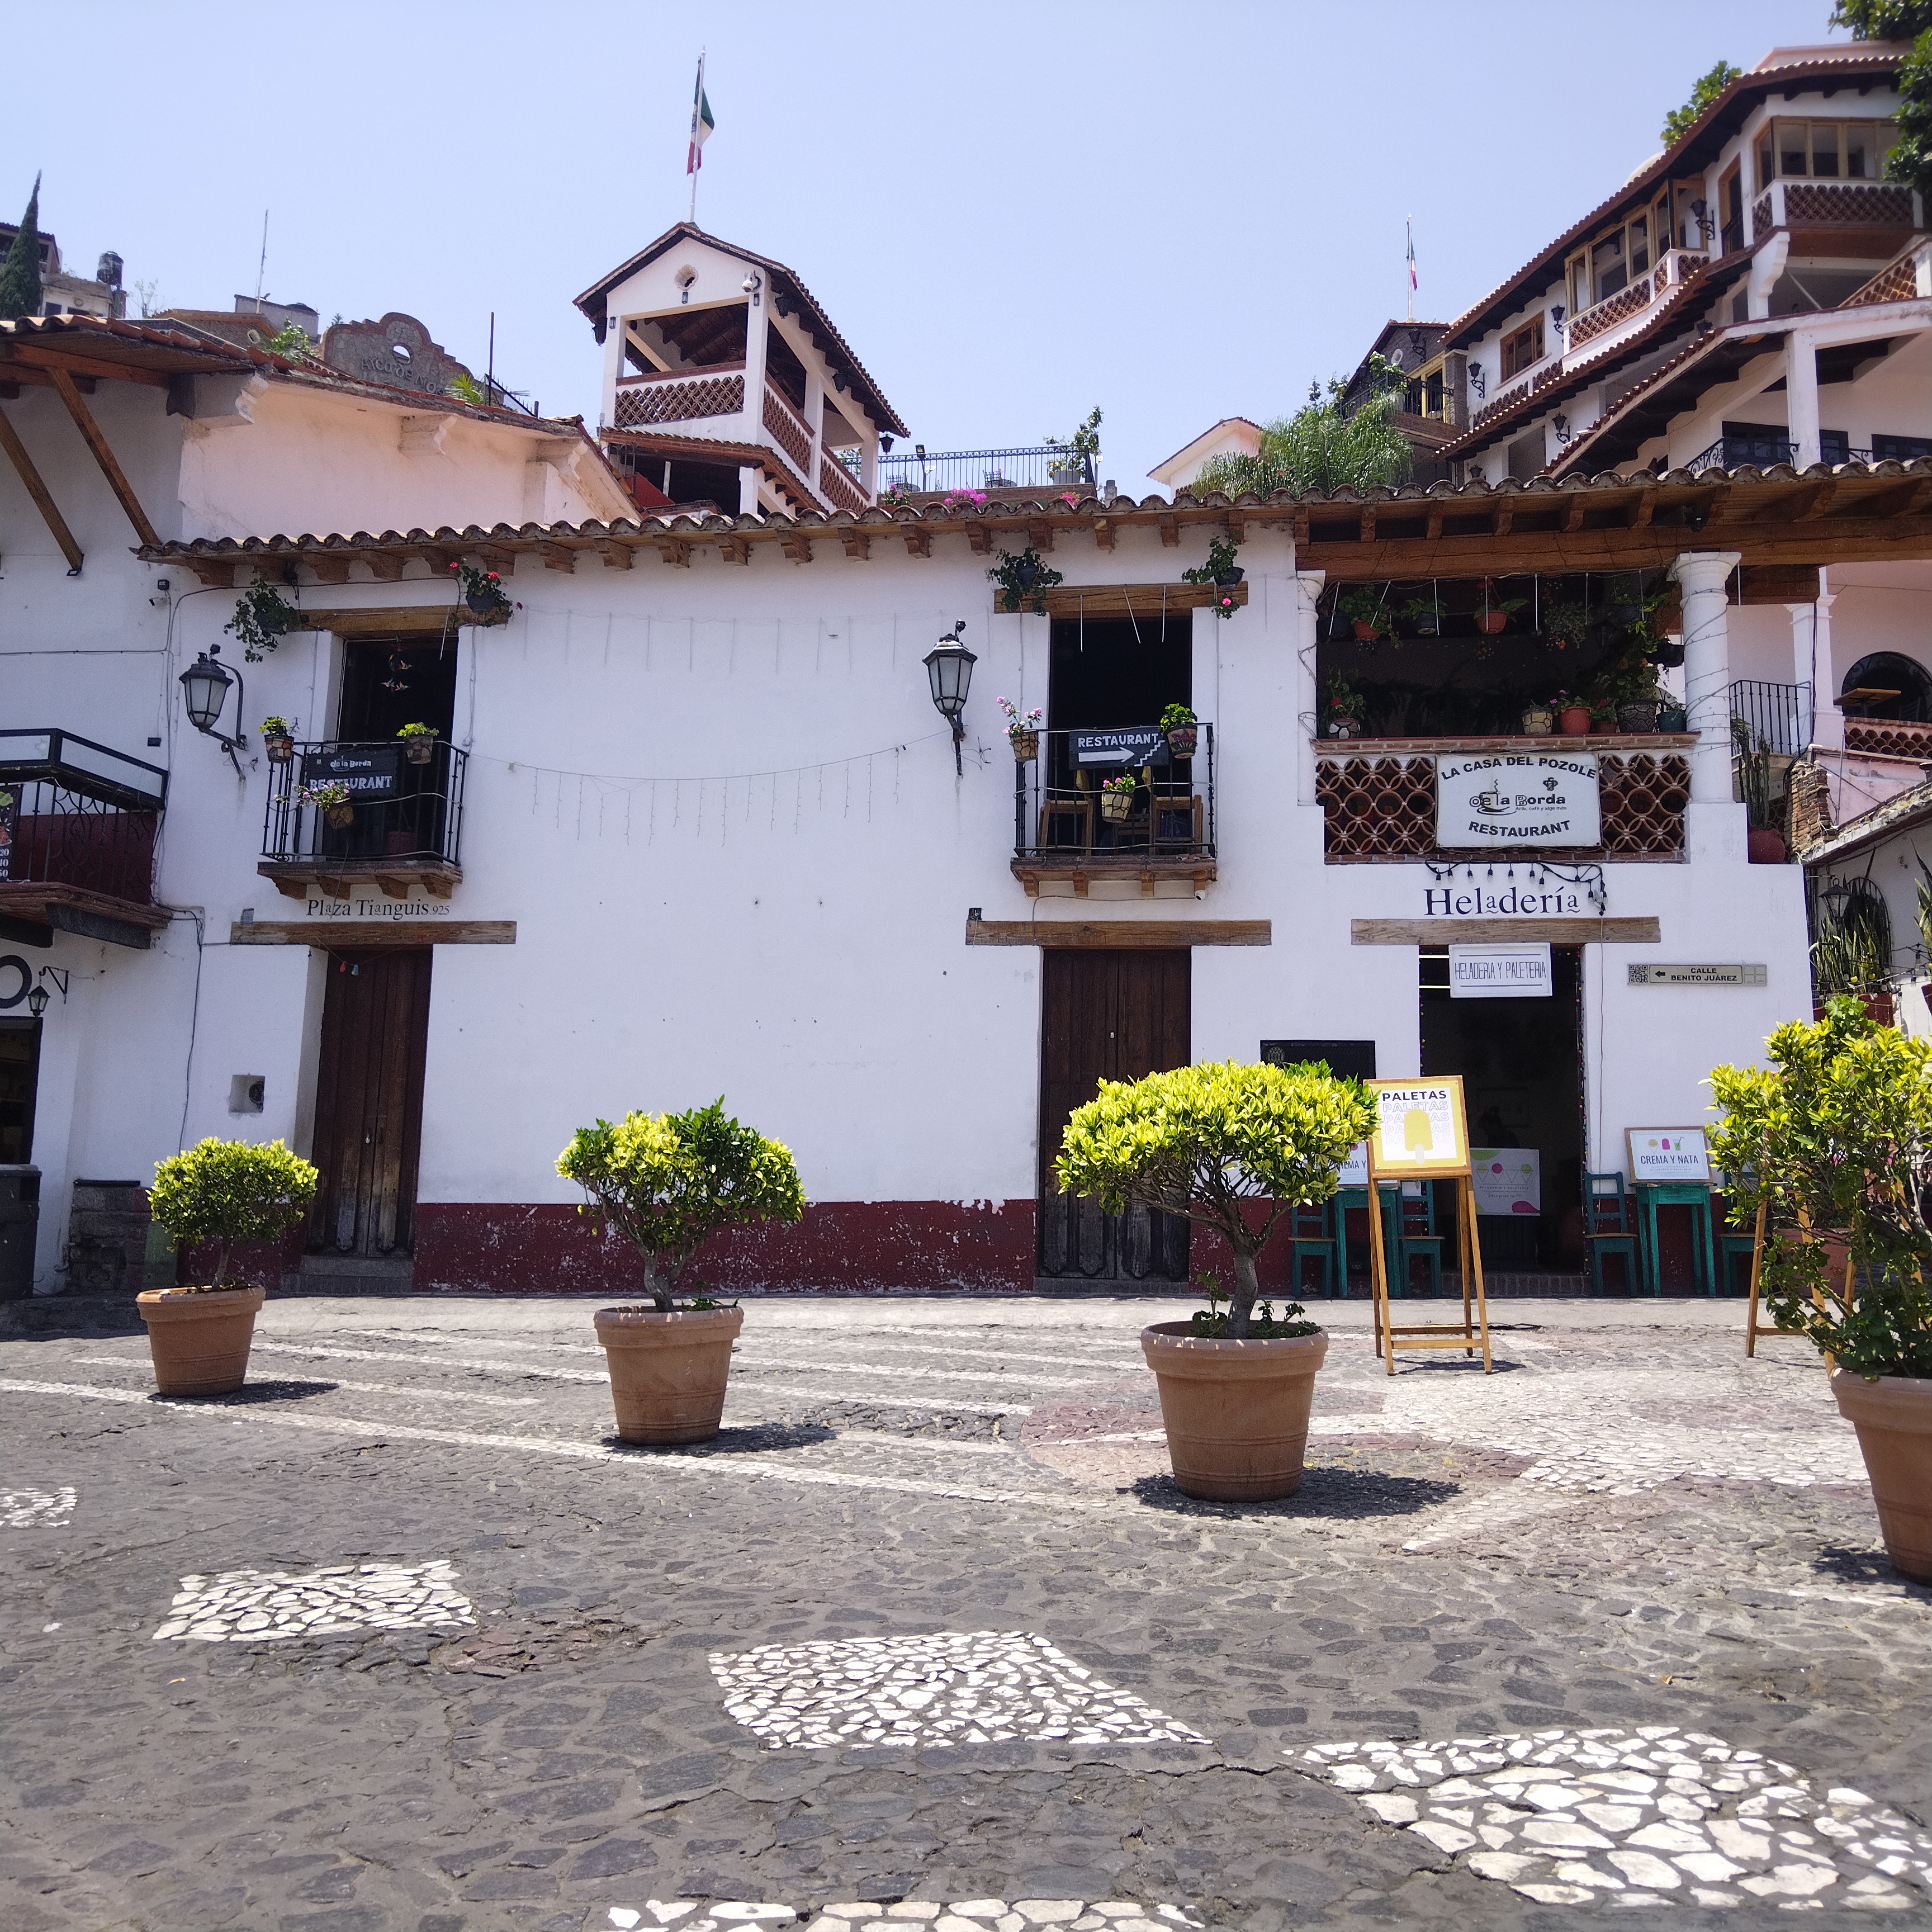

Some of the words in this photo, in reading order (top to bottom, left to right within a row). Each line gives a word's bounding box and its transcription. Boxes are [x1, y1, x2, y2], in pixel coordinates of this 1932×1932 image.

[1078, 733, 1158, 747] RESTAURANT
[349, 760, 372, 768] Borda
[1441, 768, 1460, 780] LA
[1463, 759, 1502, 772] CASA
[1507, 756, 1533, 766] DEL
[1539, 757, 1597, 779] POZOLE
[1469, 794, 1491, 807] de
[1496, 793, 1510, 806] la
[1516, 794, 1566, 806] Borda
[1469, 820, 1570, 837] RESTAURANT
[306, 899, 351, 917] Plaza
[1423, 887, 1580, 915] Heladería
[1455, 962, 1495, 979] HELADERIA
[1498, 962, 1502, 978] Y
[1506, 962, 1546, 978] PALETERIA
[1382, 1090, 1447, 1101] PALETAS
[1383, 1101, 1448, 1112] PALETAS
[1640, 1156, 1668, 1164] CREMA
[1670, 1155, 1675, 1163] Y
